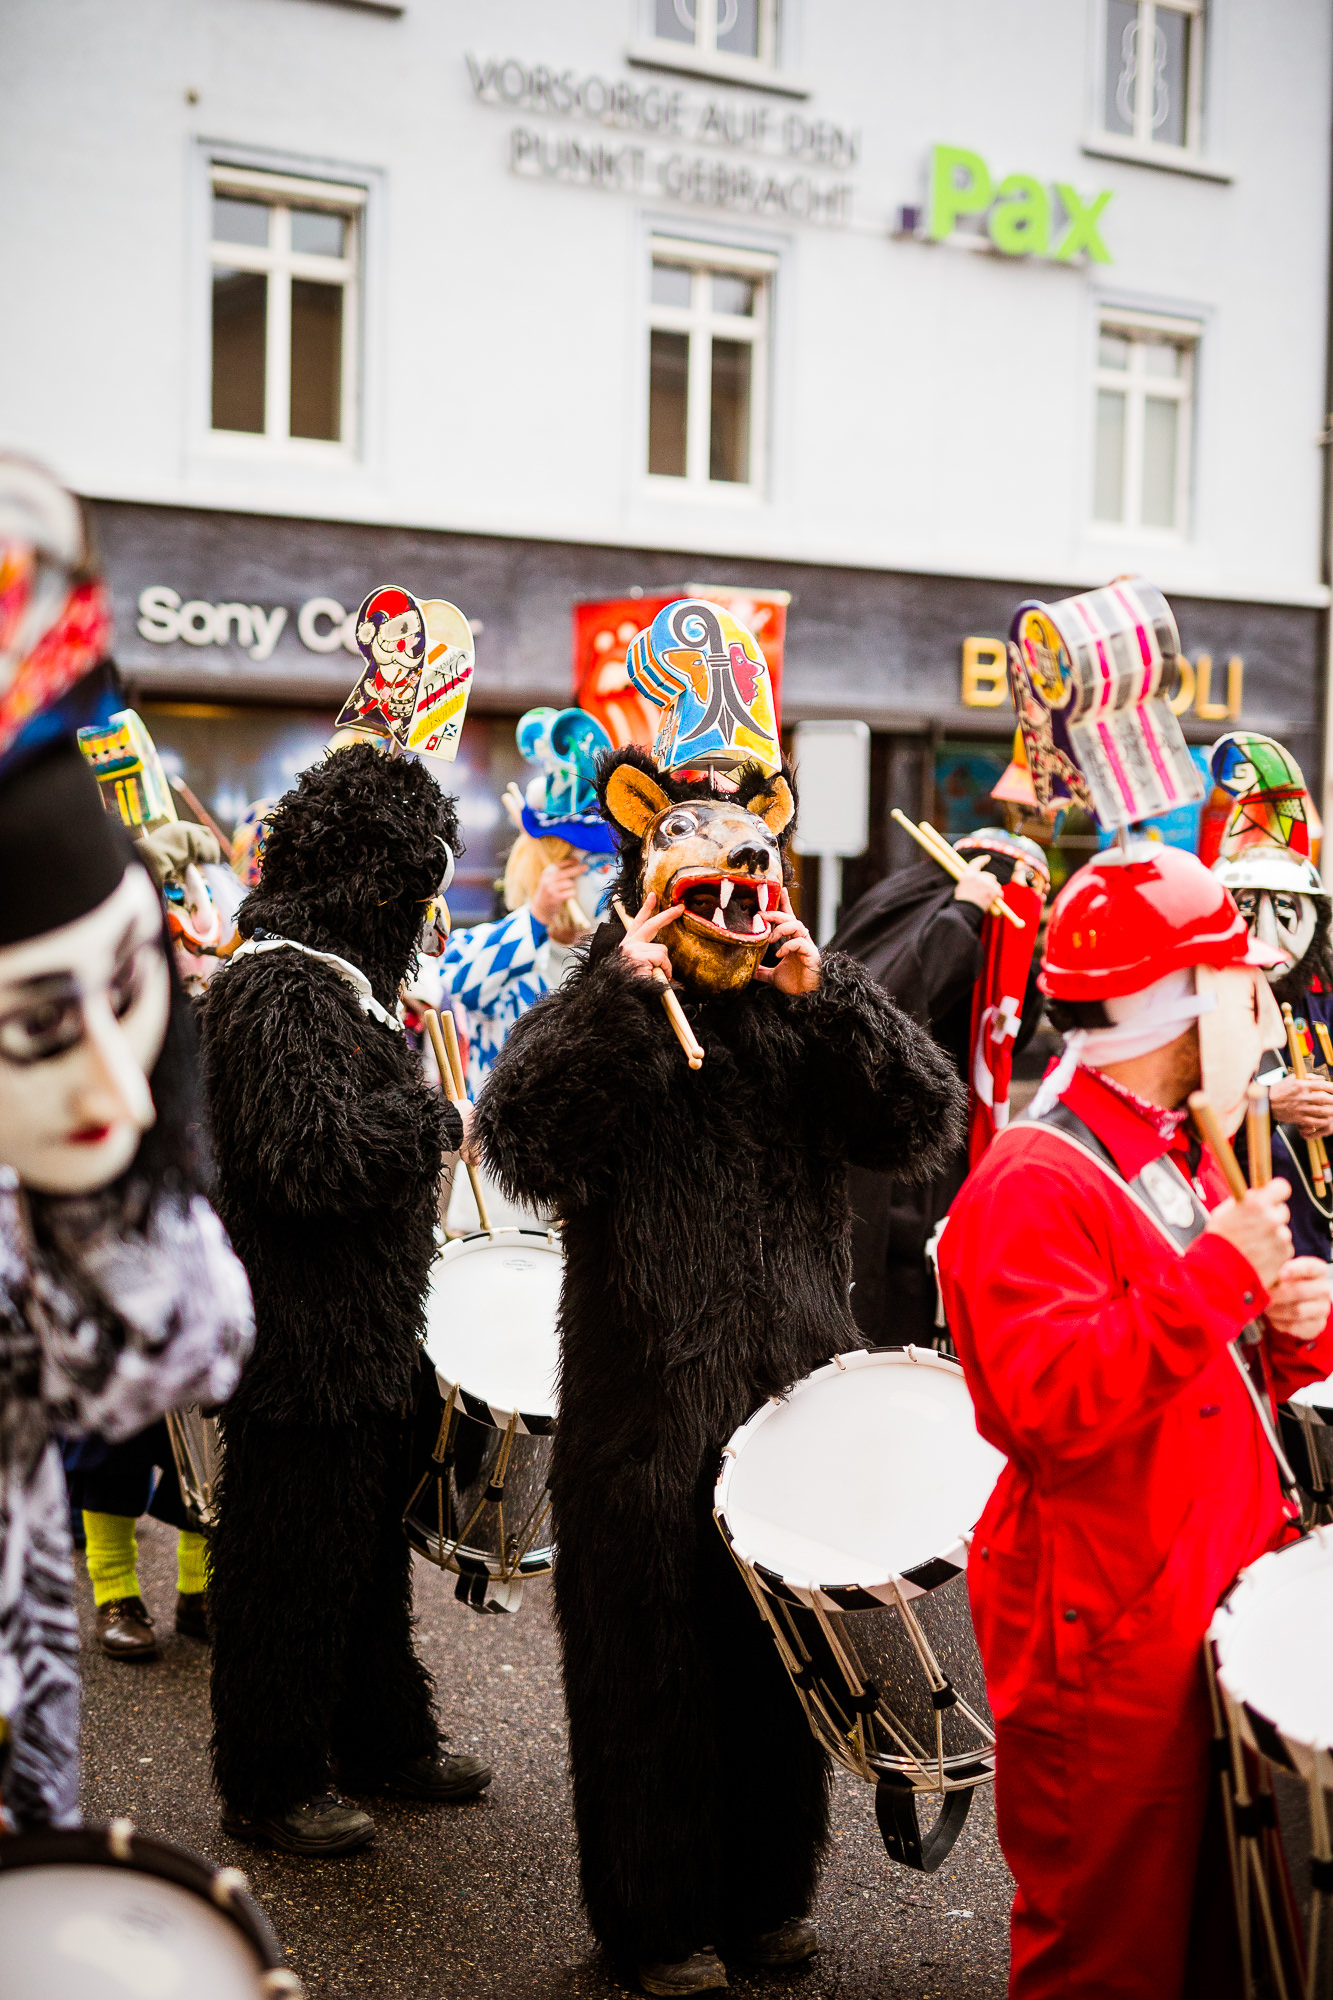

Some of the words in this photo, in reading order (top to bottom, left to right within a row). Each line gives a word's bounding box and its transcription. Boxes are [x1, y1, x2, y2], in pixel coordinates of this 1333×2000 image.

[465, 52, 684, 134] VORSORGE
[702, 100, 770, 149] AUF
[783, 113, 861, 168] DEN
[511, 127, 645, 188] PUNKT
[657, 155, 856, 223] GEBRACHT
[929, 144, 1114, 264] Pax
[137, 585, 288, 660] Sony
